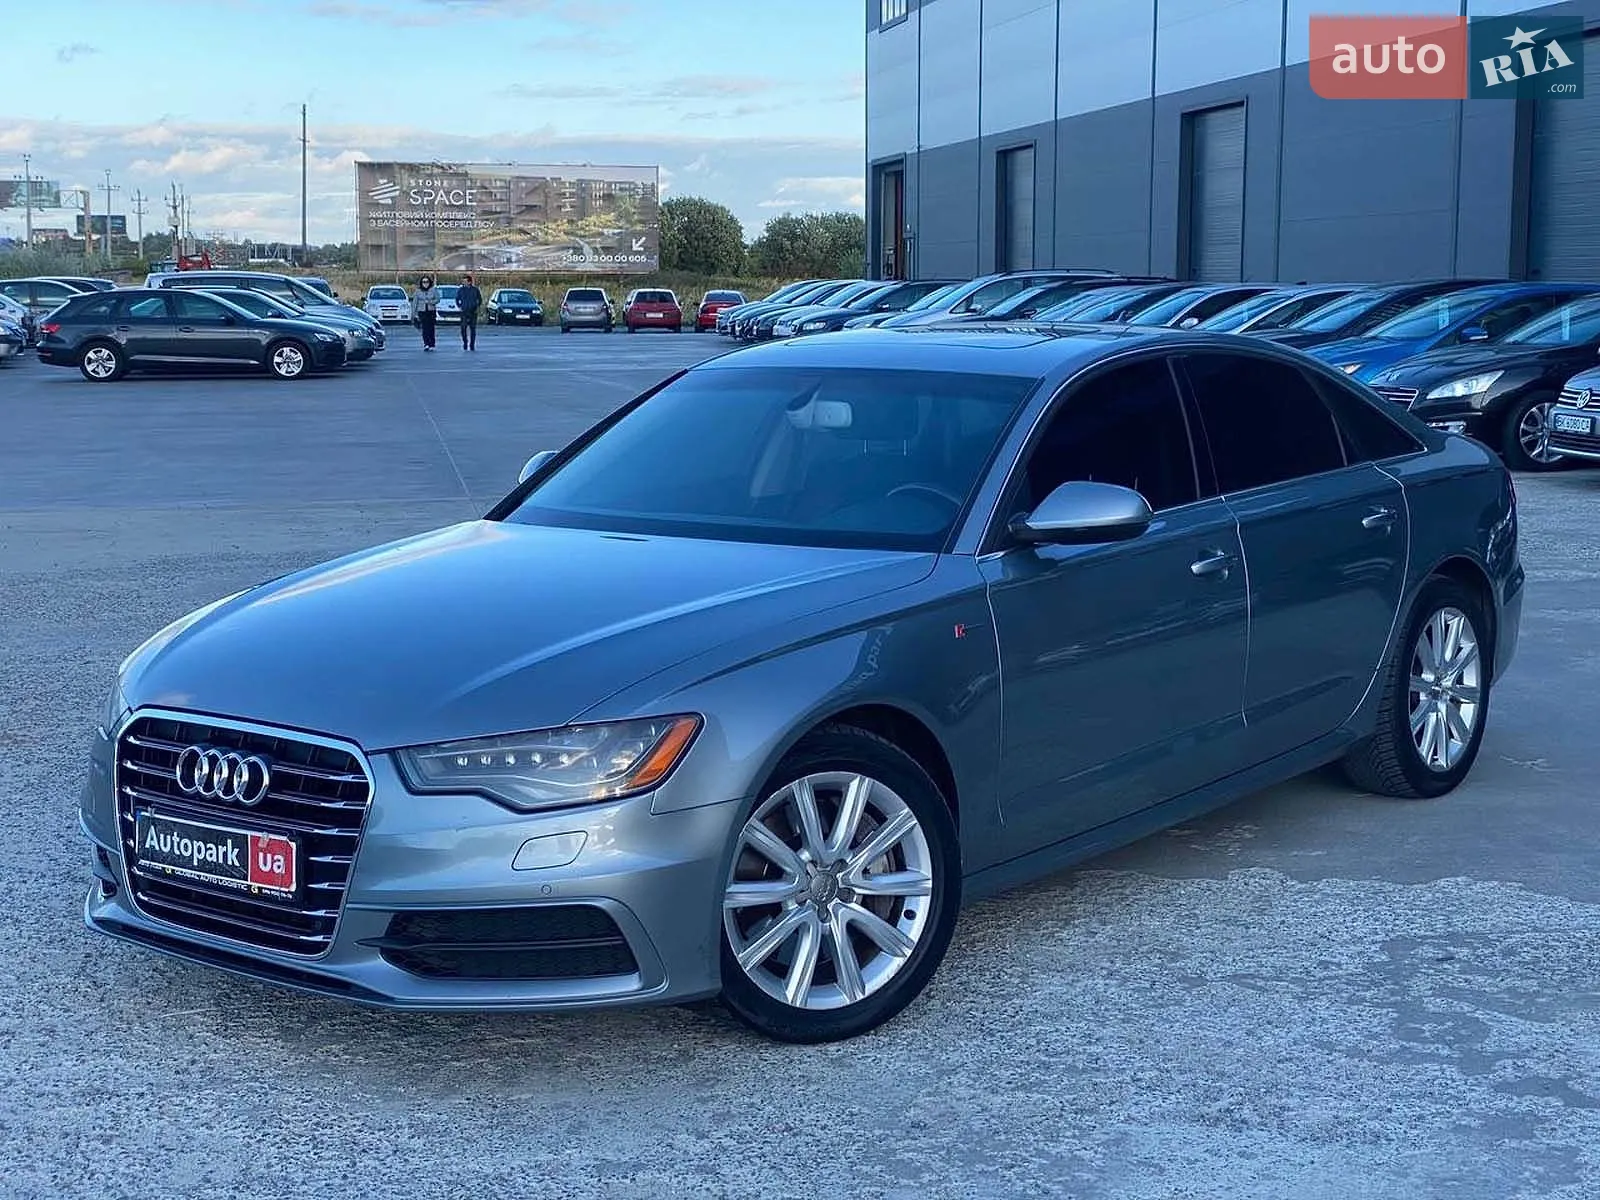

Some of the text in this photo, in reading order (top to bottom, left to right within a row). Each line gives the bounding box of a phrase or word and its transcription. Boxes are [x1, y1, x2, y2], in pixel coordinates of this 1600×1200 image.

[409, 189, 477, 206] SPACE
[425, 211, 476, 219] КОМПЛЕКС
[432, 220, 473, 228] ПОСЕРЕД
[145, 825, 285, 875] Autopark ua
[174, 868, 248, 891] GLOBAL AUTO LOGISTIC
